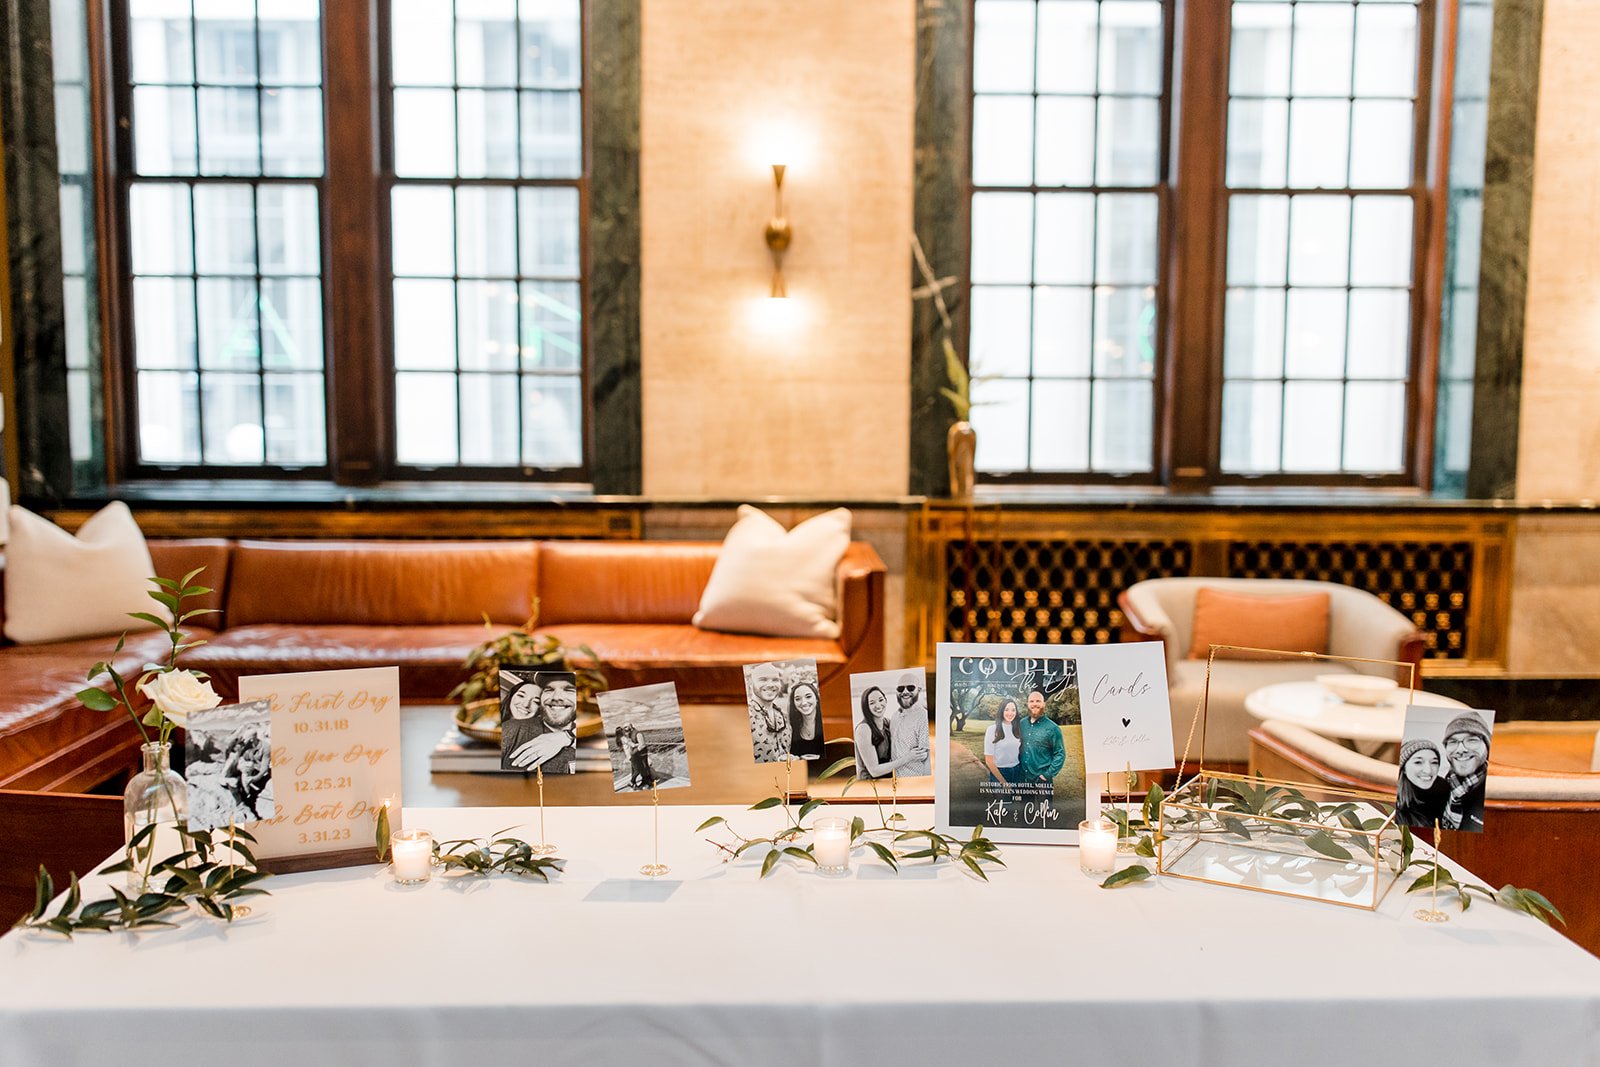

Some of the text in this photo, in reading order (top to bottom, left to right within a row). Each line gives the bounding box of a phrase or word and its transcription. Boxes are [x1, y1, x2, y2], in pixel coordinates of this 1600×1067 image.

[958, 657, 1076, 677] COUPLE
[1011, 668, 1045, 693] The
[1092, 671, 1151, 704] Cards
[288, 691, 344, 714] First
[347, 690, 393, 713] Day
[293, 718, 349, 734] 10.31.18
[295, 749, 338, 776] Yes
[343, 743, 390, 766] Day
[294, 776, 352, 792] 12.25.21
[294, 801, 342, 825] Best
[985, 799, 1012, 826] Kate
[1024, 799, 1059, 828] Collin
[298, 828, 351, 844] 3.31.23
